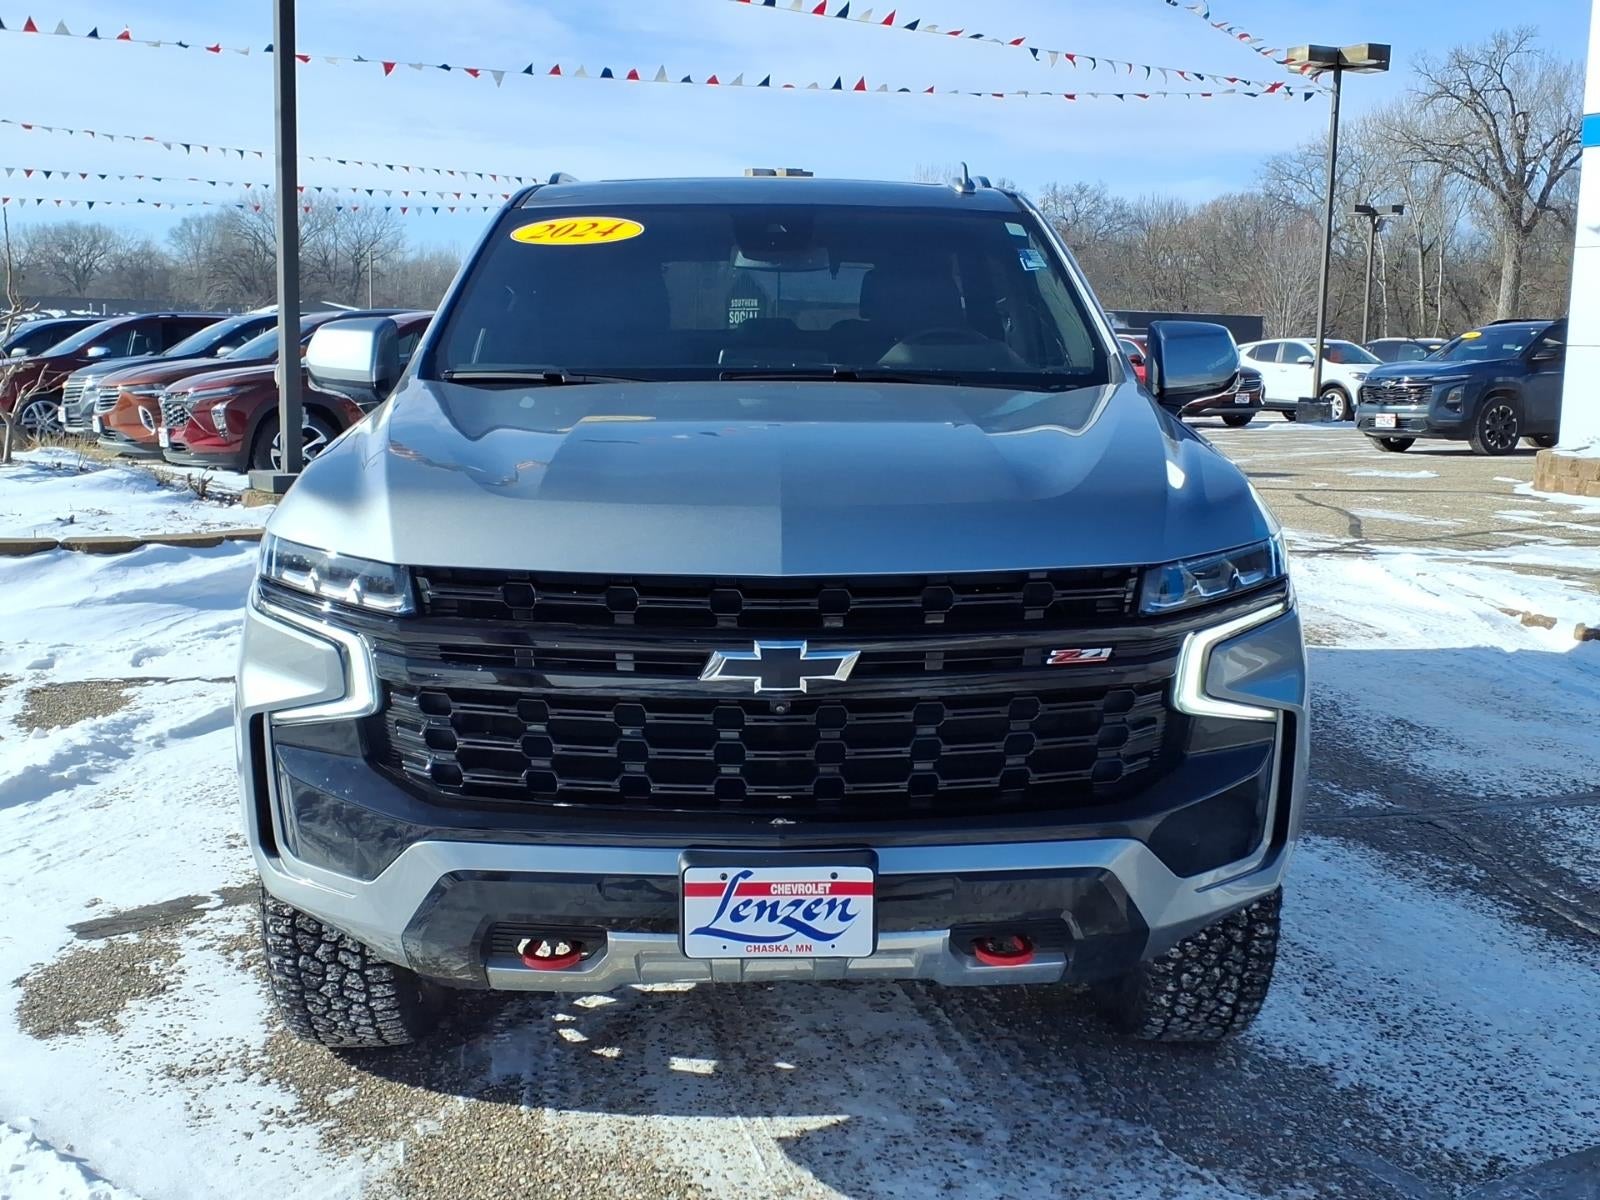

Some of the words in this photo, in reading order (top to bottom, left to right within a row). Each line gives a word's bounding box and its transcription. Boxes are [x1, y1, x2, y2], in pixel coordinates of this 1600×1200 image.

[526, 221, 625, 240] 2024
[731, 298, 758, 307] SOUTHERN
[1046, 647, 1112, 665] Z71
[770, 883, 831, 895] CHEVROLET
[690, 869, 862, 944] Lenzen
[745, 944, 793, 954] CHASKA,
[795, 944, 813, 953] MN
